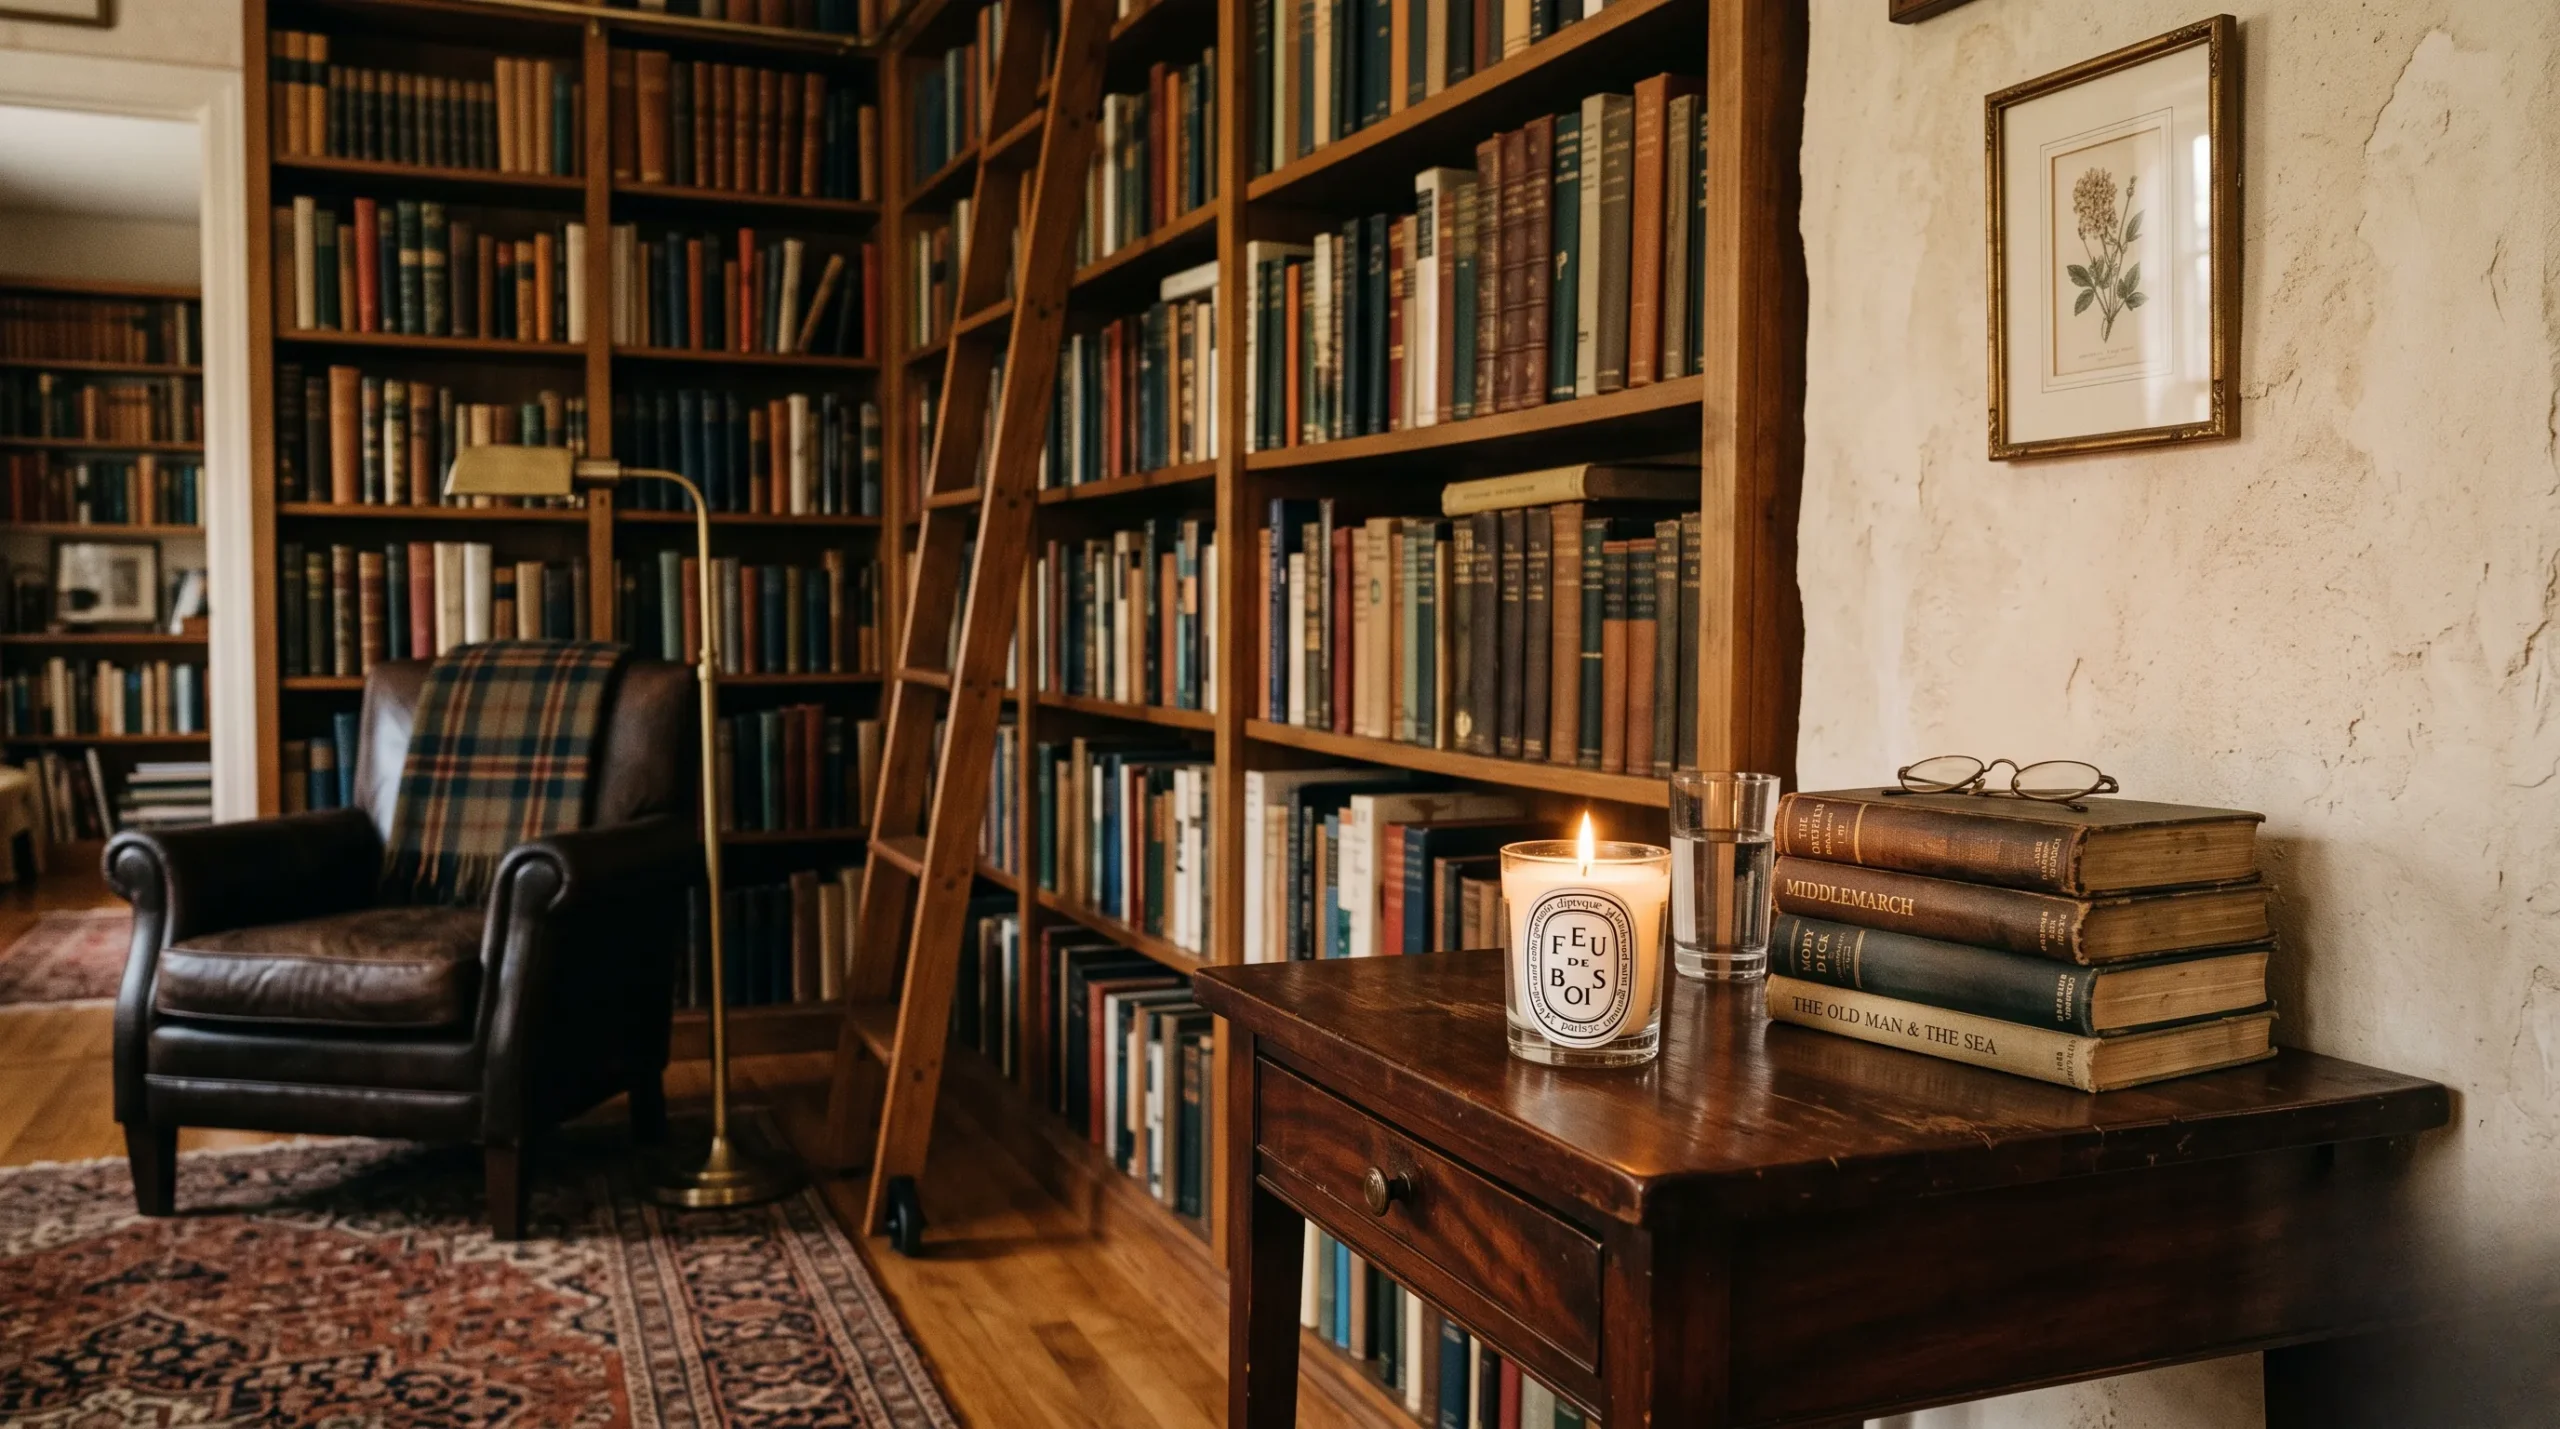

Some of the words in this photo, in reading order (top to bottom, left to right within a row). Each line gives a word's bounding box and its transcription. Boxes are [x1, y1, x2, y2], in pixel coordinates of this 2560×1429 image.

[1786, 879, 1914, 916] MIDDLEMARCH
[1552, 927, 1607, 957] FEU
[1801, 928, 1815, 972] MOBY
[1816, 933, 1830, 973] DICK
[1567, 957, 1590, 968] DE
[1551, 968, 1606, 1006] BOIS
[1792, 995, 1823, 1016] THE
[1827, 1003, 1860, 1024] OLD
[1864, 1011, 1904, 1033] MAN
[1907, 1021, 1920, 1038] &
[1924, 1024, 1959, 1047] THE
[1964, 1033, 1998, 1056] SEA
